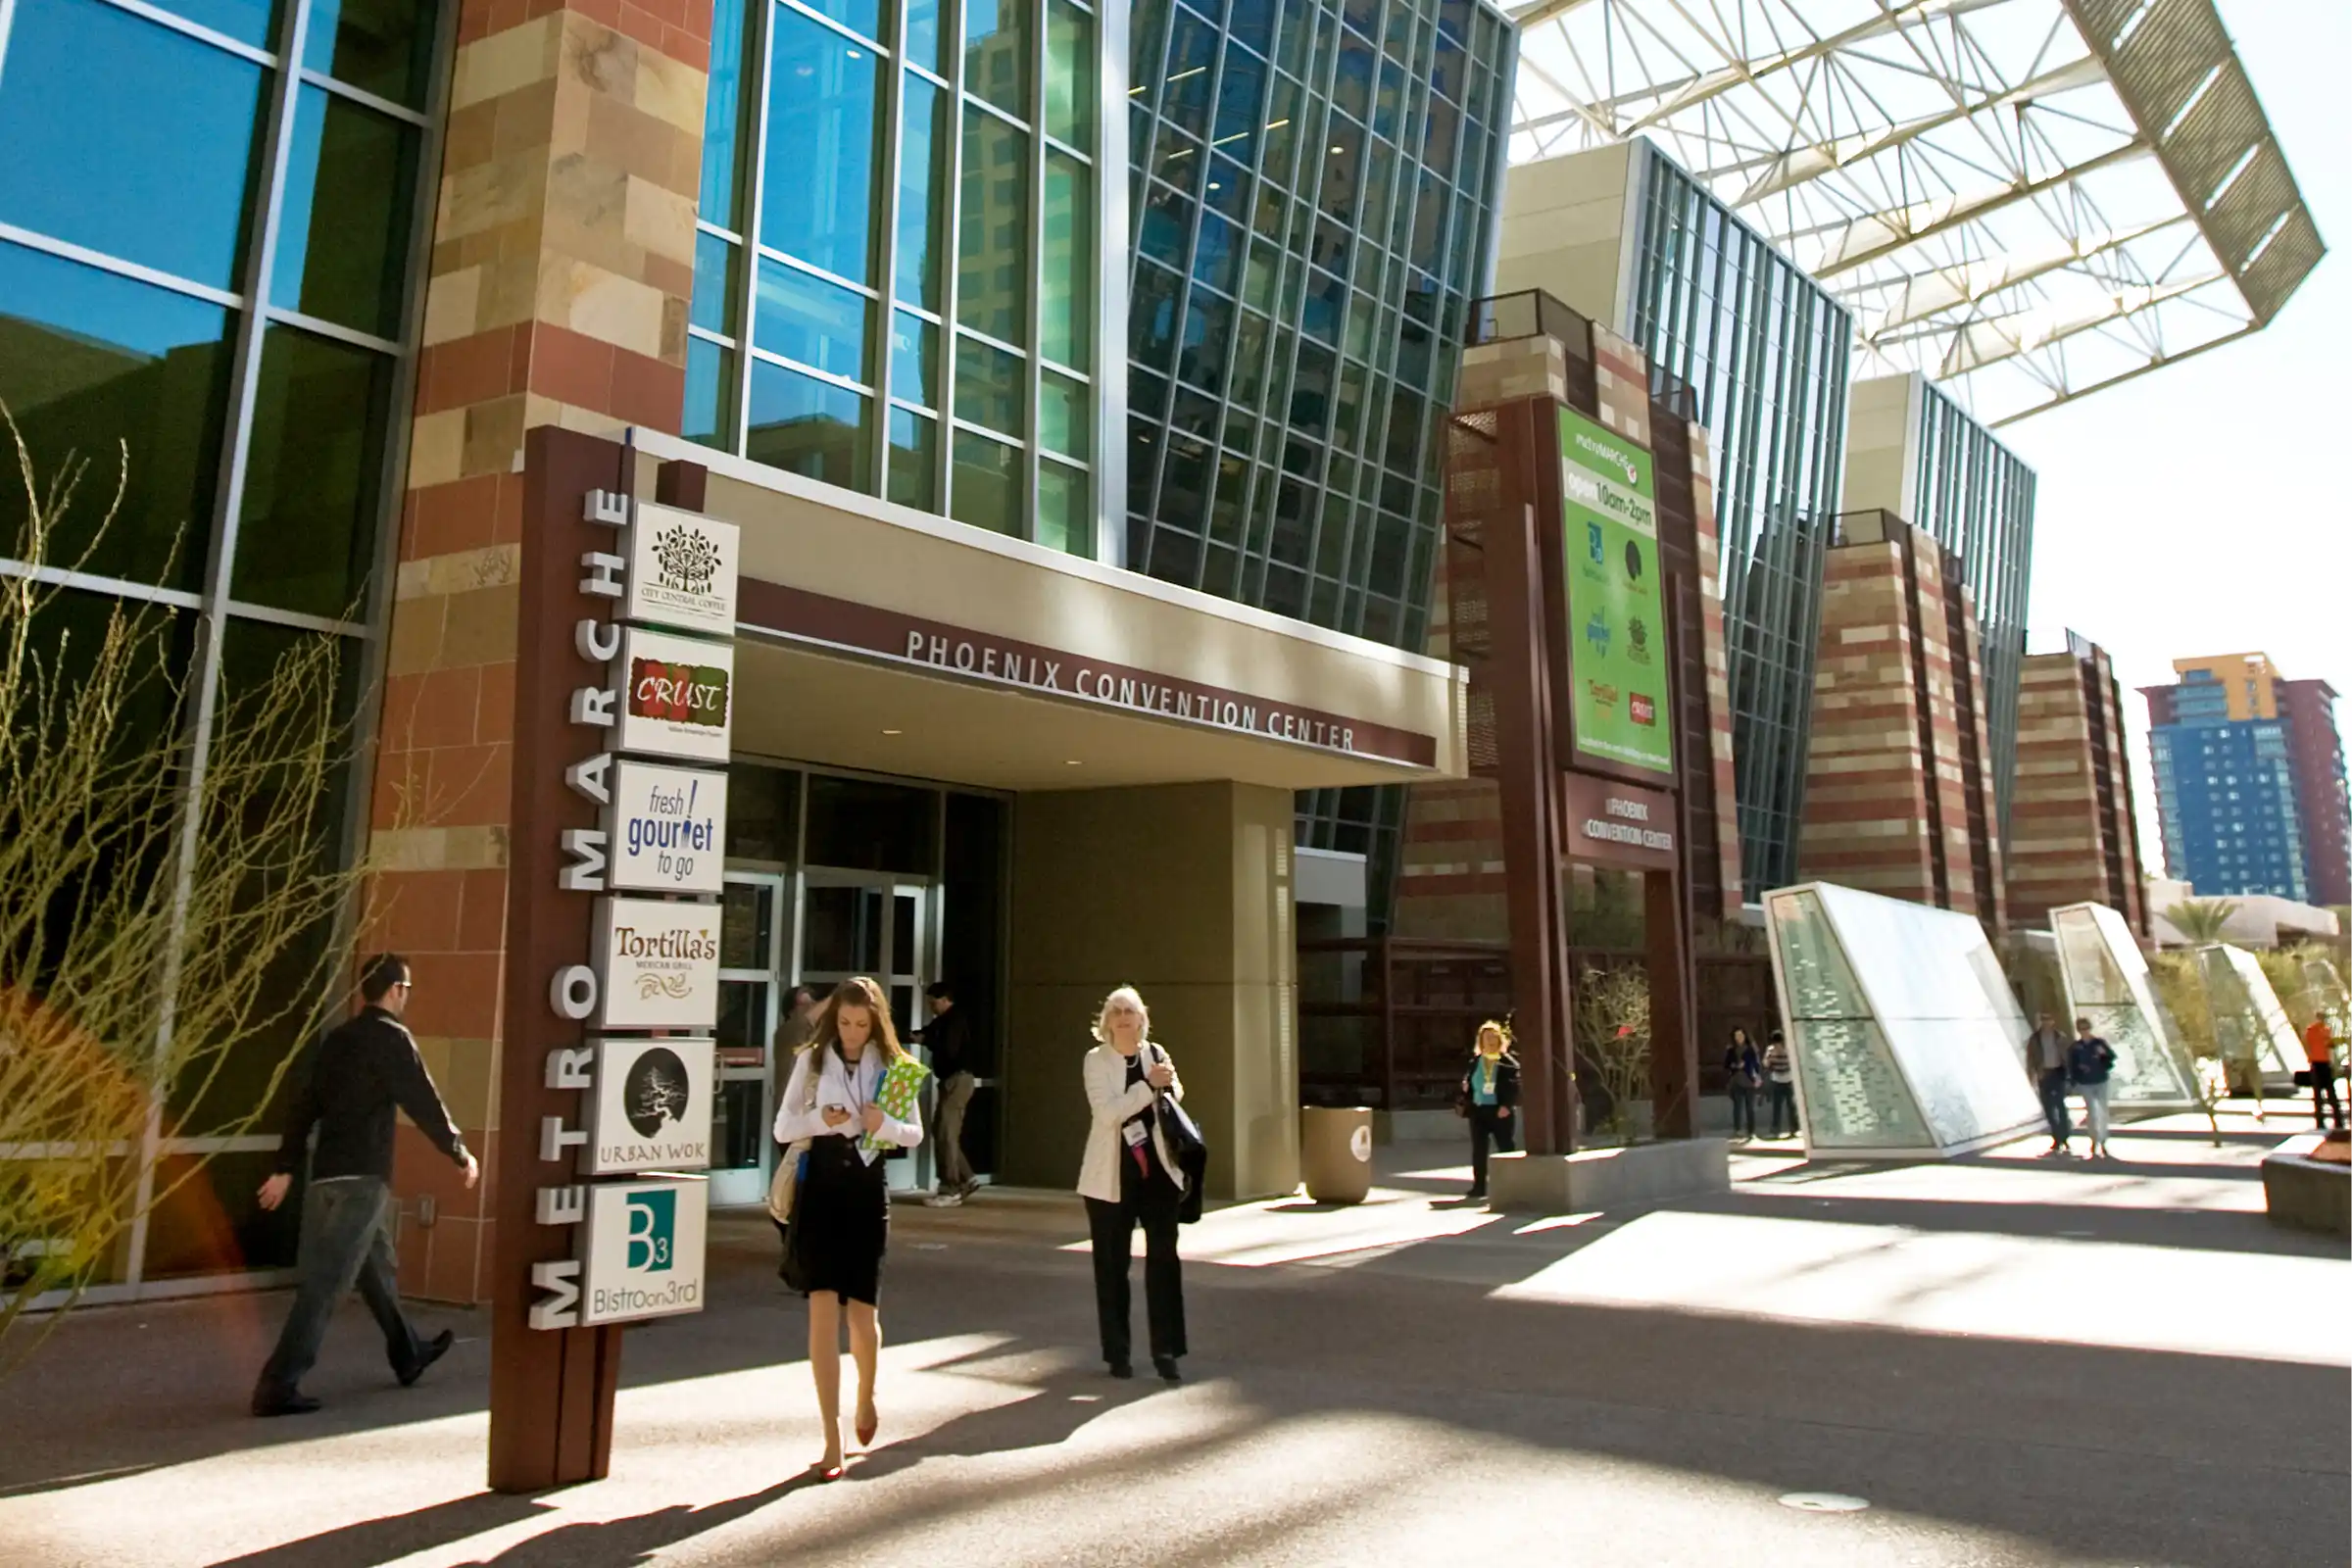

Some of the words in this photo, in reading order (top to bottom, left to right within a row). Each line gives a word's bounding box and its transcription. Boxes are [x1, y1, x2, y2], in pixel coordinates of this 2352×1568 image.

[662, 591, 697, 606] CENTRAL
[699, 599, 727, 612] COFFEE
[559, 488, 628, 892] MARCHE
[637, 676, 721, 710] CRUST
[906, 630, 1060, 688] PHOENIX
[1076, 668, 1257, 731] CONVENTION
[1267, 711, 1355, 752] CENTER
[1606, 798, 1648, 821] PHOENIX
[627, 817, 713, 857] gouret
[1585, 819, 1642, 846] CONVENTION
[1642, 830, 1673, 851] CENTER
[657, 850, 672, 874] to
[674, 857, 694, 881] go
[636, 960, 670, 969] MEXICAN
[529, 964, 597, 1330] METRO
[601, 1144, 662, 1163] URBAN
[667, 1143, 706, 1158] WOK
